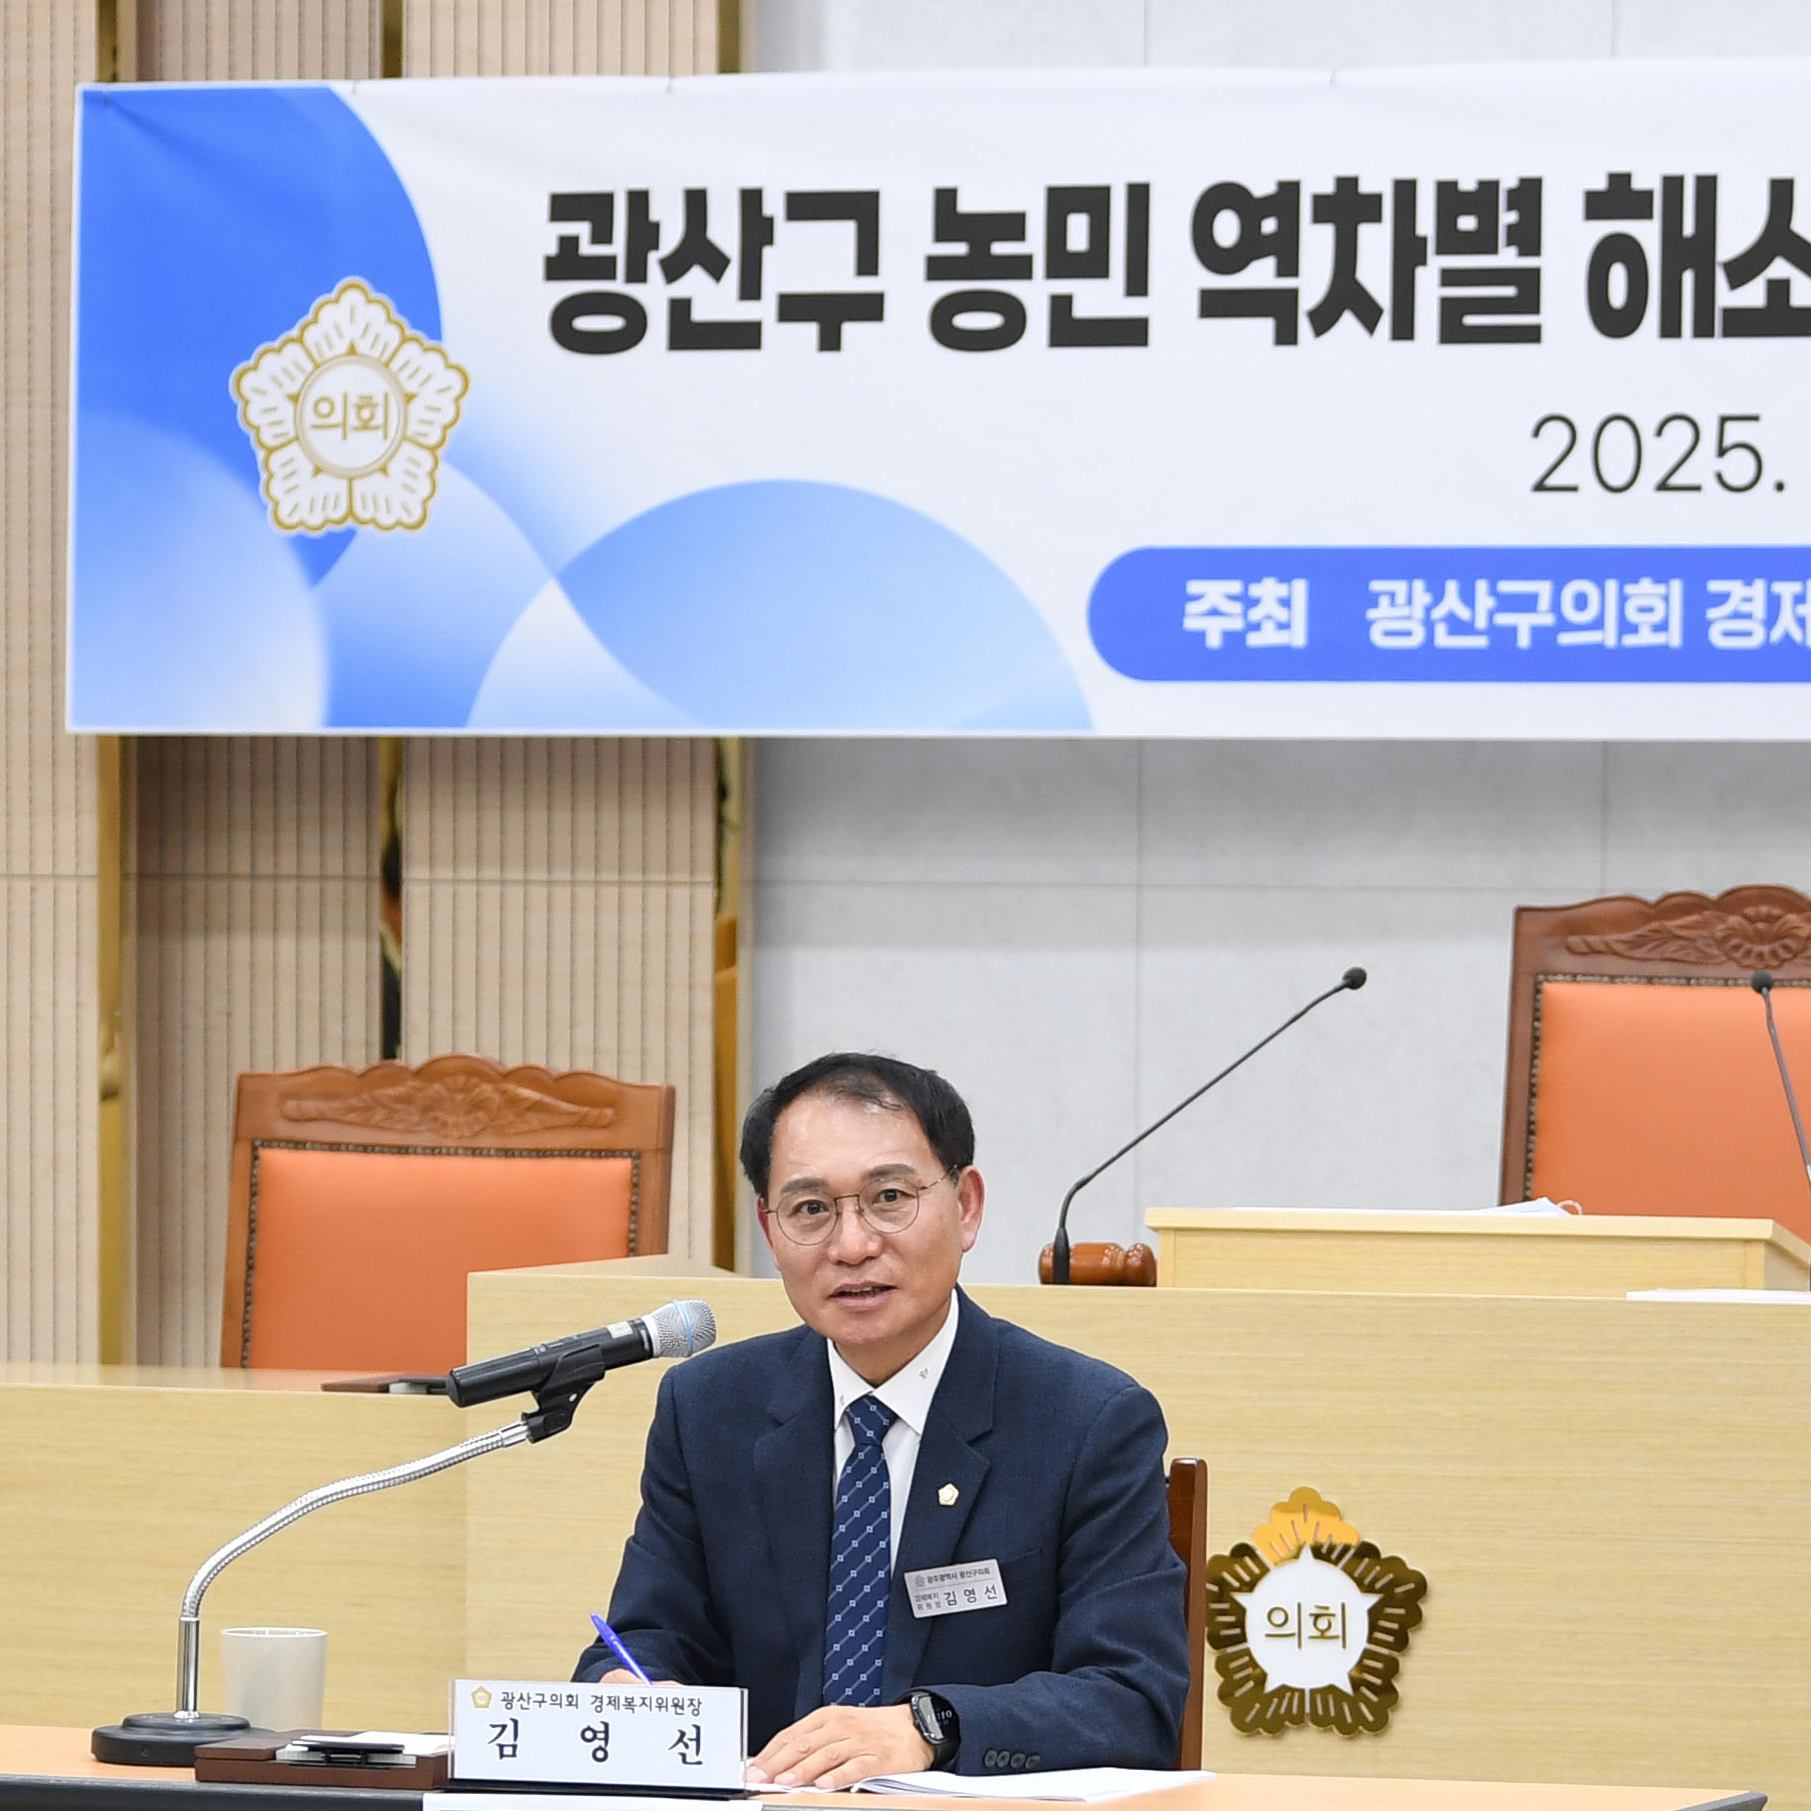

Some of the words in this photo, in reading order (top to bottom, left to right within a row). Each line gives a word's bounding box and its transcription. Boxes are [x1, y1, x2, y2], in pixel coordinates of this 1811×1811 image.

[545, 189, 884, 354] 광산구
[927, 184, 1149, 352] 농민
[1192, 177, 1542, 345] 역차별
[312, 394, 388, 440] 의회
[1533, 414, 1784, 493] 2025.
[1184, 578, 1306, 647] 주최
[1367, 579, 1681, 647] 광산구의회
[1266, 1603, 1346, 1648] 의회
[500, 1691, 579, 1710] 광산구의회
[590, 1694, 702, 1717] 경제복지위원장
